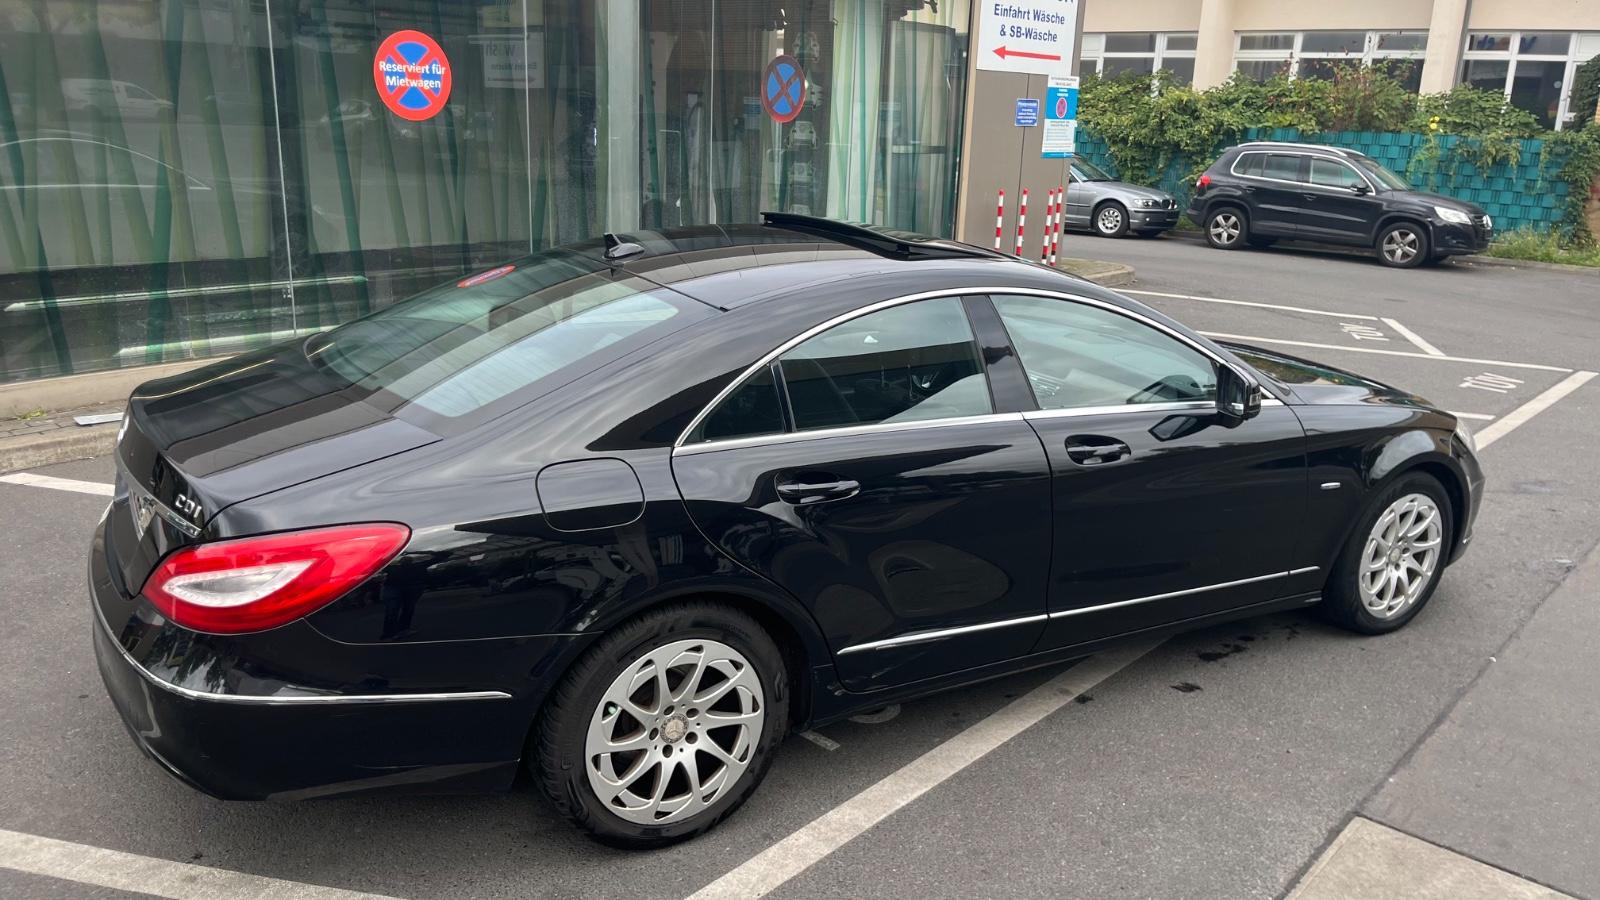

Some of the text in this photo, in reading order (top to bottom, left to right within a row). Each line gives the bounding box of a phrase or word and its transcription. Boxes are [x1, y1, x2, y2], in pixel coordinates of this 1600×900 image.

[994, 3, 1065, 24] Einfahrt Wäsche
[999, 24, 1058, 42] & SB-Wäsche
[379, 60, 446, 75] Reserviert für
[385, 75, 441, 90] Mietwagen
[175, 493, 202, 518] CDI
